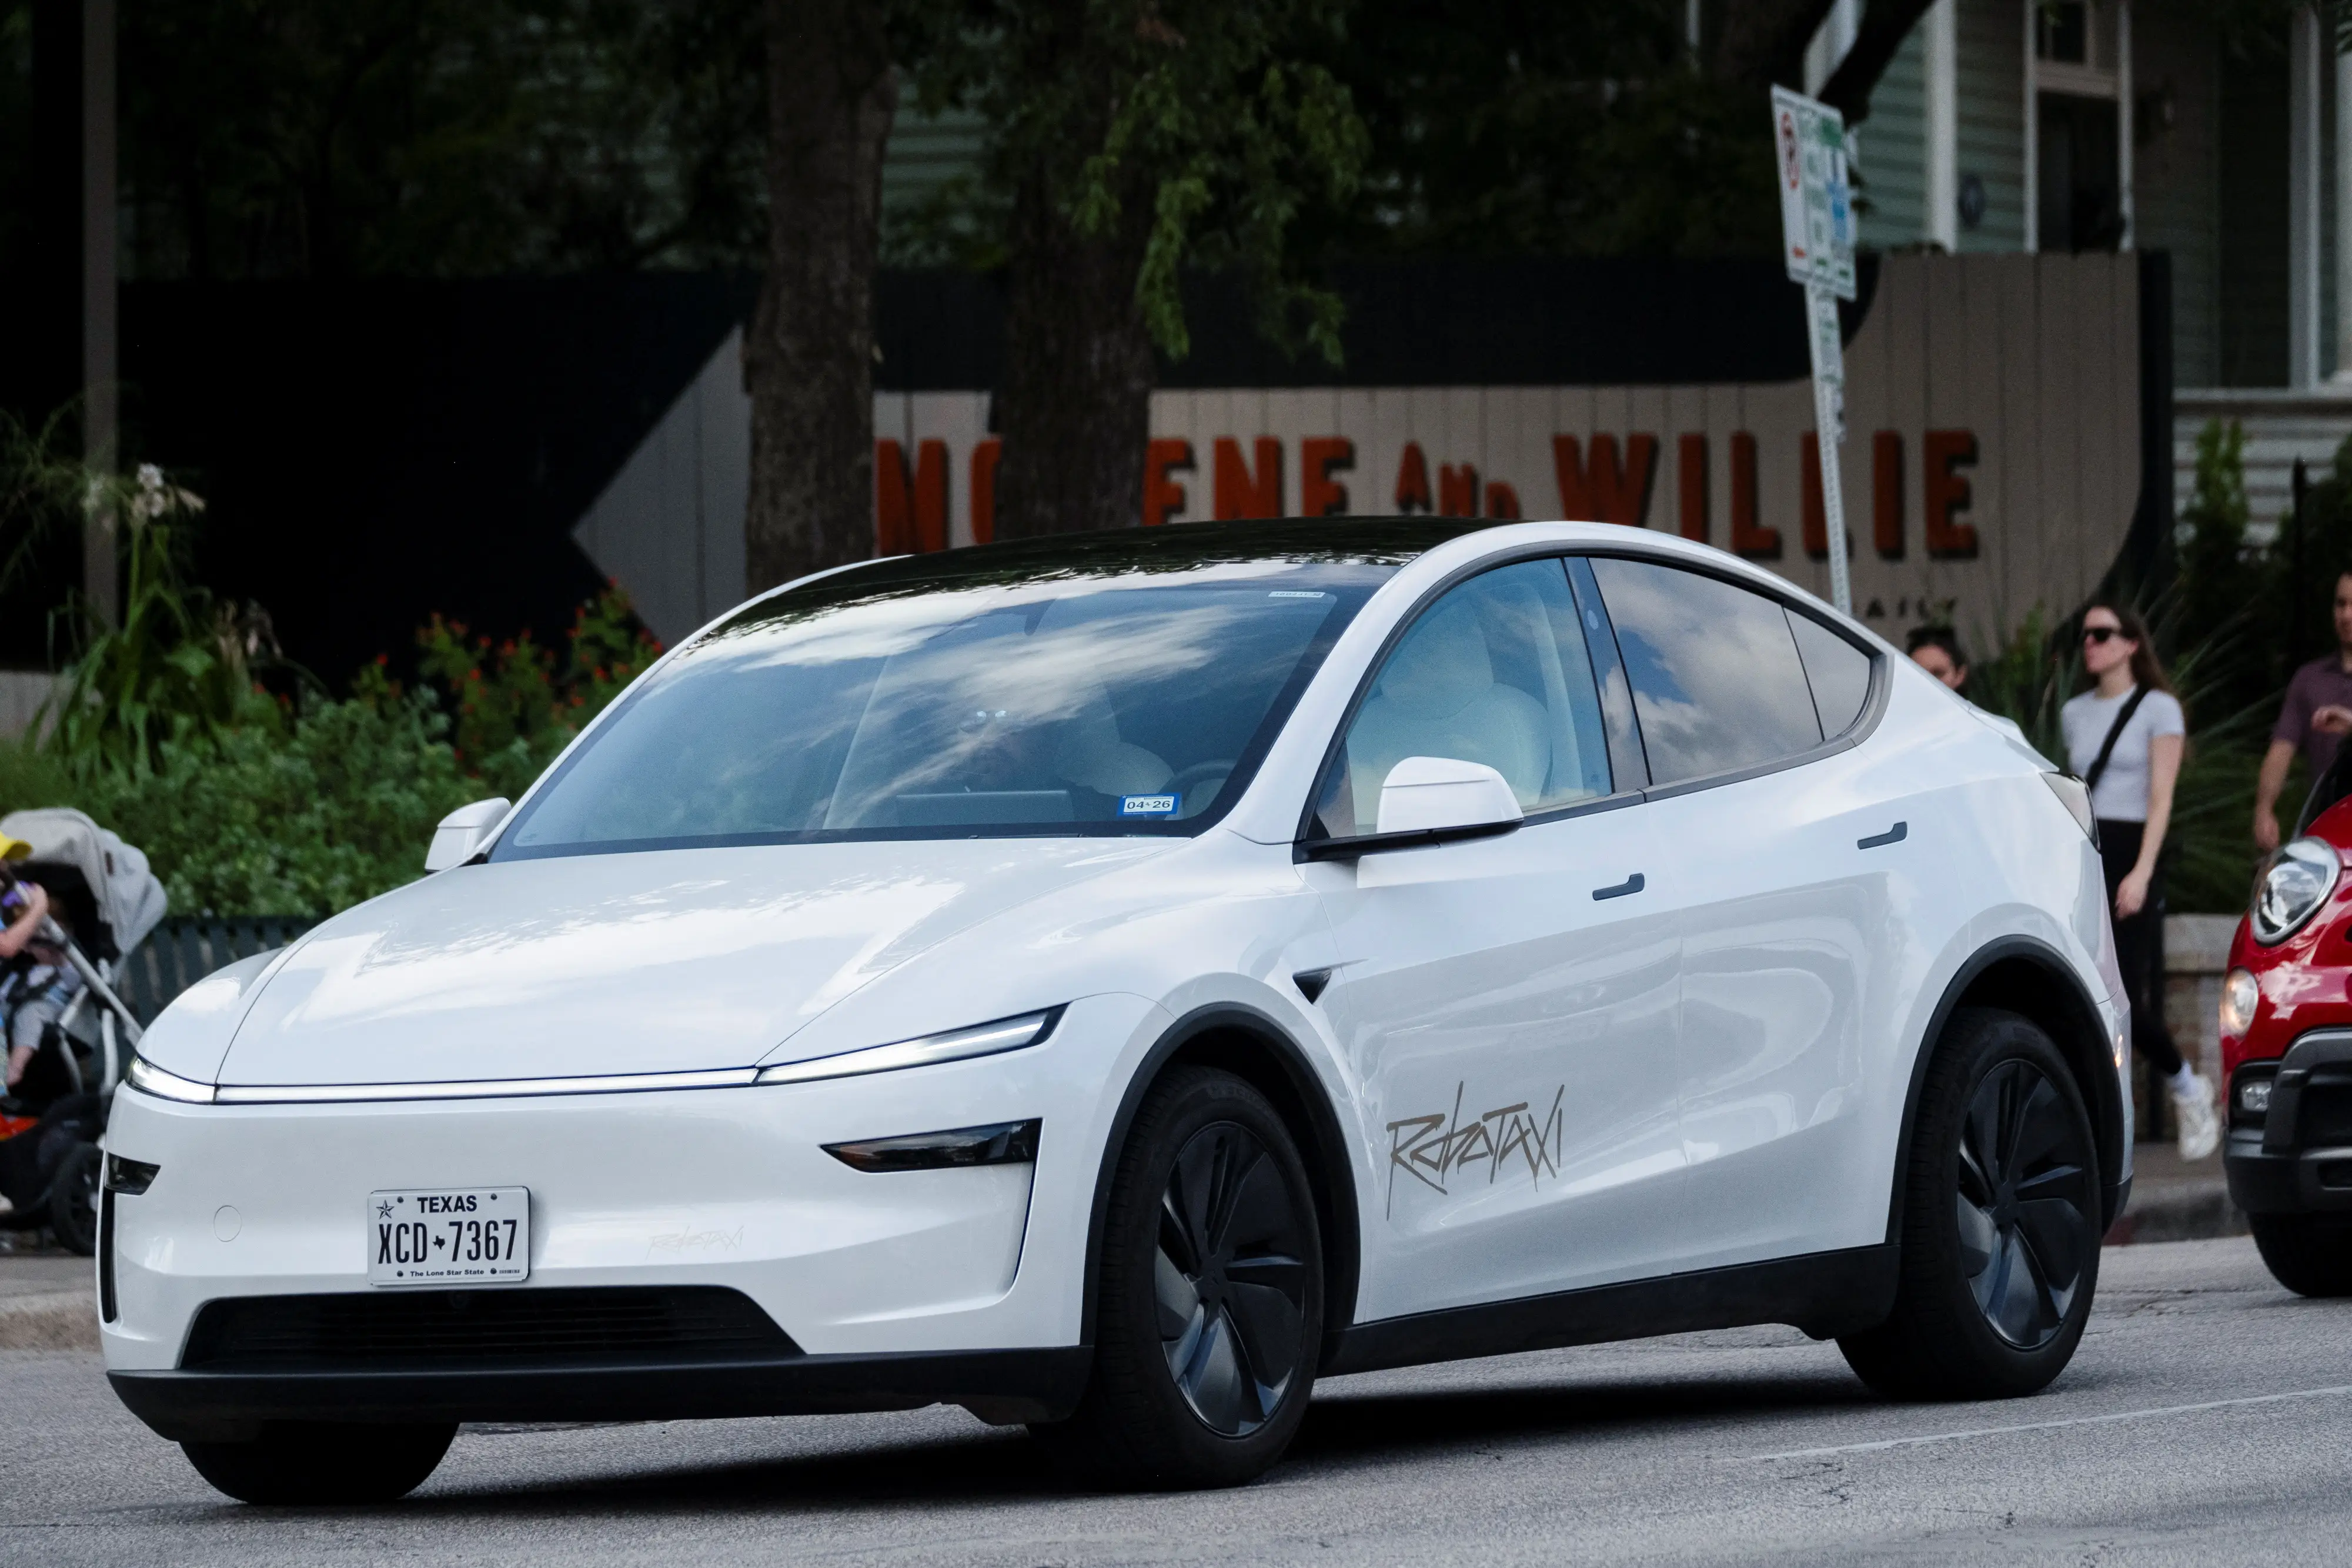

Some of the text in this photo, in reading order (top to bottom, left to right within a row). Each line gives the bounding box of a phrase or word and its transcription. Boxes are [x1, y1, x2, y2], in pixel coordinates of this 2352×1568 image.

[1553, 430, 1976, 557] WILLIE
[417, 1195, 477, 1213] TEXAS
[378, 1219, 517, 1264] XCD 7367
